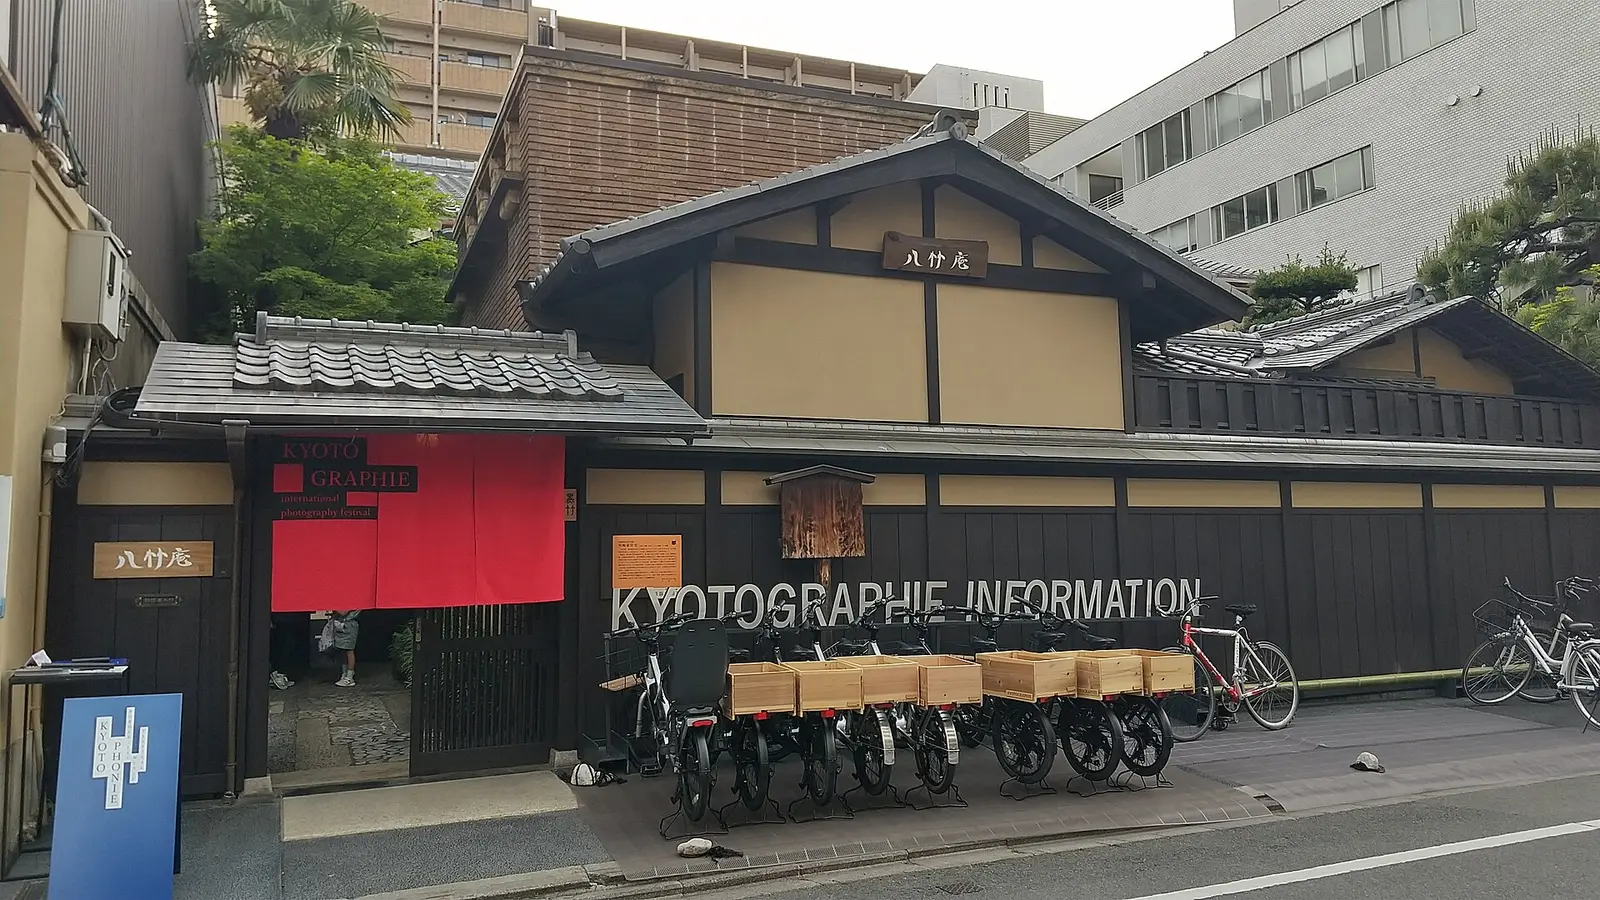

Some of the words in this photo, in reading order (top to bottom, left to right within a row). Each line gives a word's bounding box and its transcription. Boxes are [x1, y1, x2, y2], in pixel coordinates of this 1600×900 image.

[903, 249, 970, 270] 八竹庵
[283, 442, 360, 459] KYOTO
[311, 470, 411, 487] GRAPHIE
[281, 493, 340, 503] international
[280, 507, 338, 519] photography
[340, 507, 371, 517] festival
[114, 547, 193, 570] 八竹庵
[611, 581, 948, 632] KYOTOGRAPHIE
[965, 578, 1201, 622] INFORMATION
[96, 721, 108, 773] KYOTO
[110, 741, 121, 804] PHONIE
